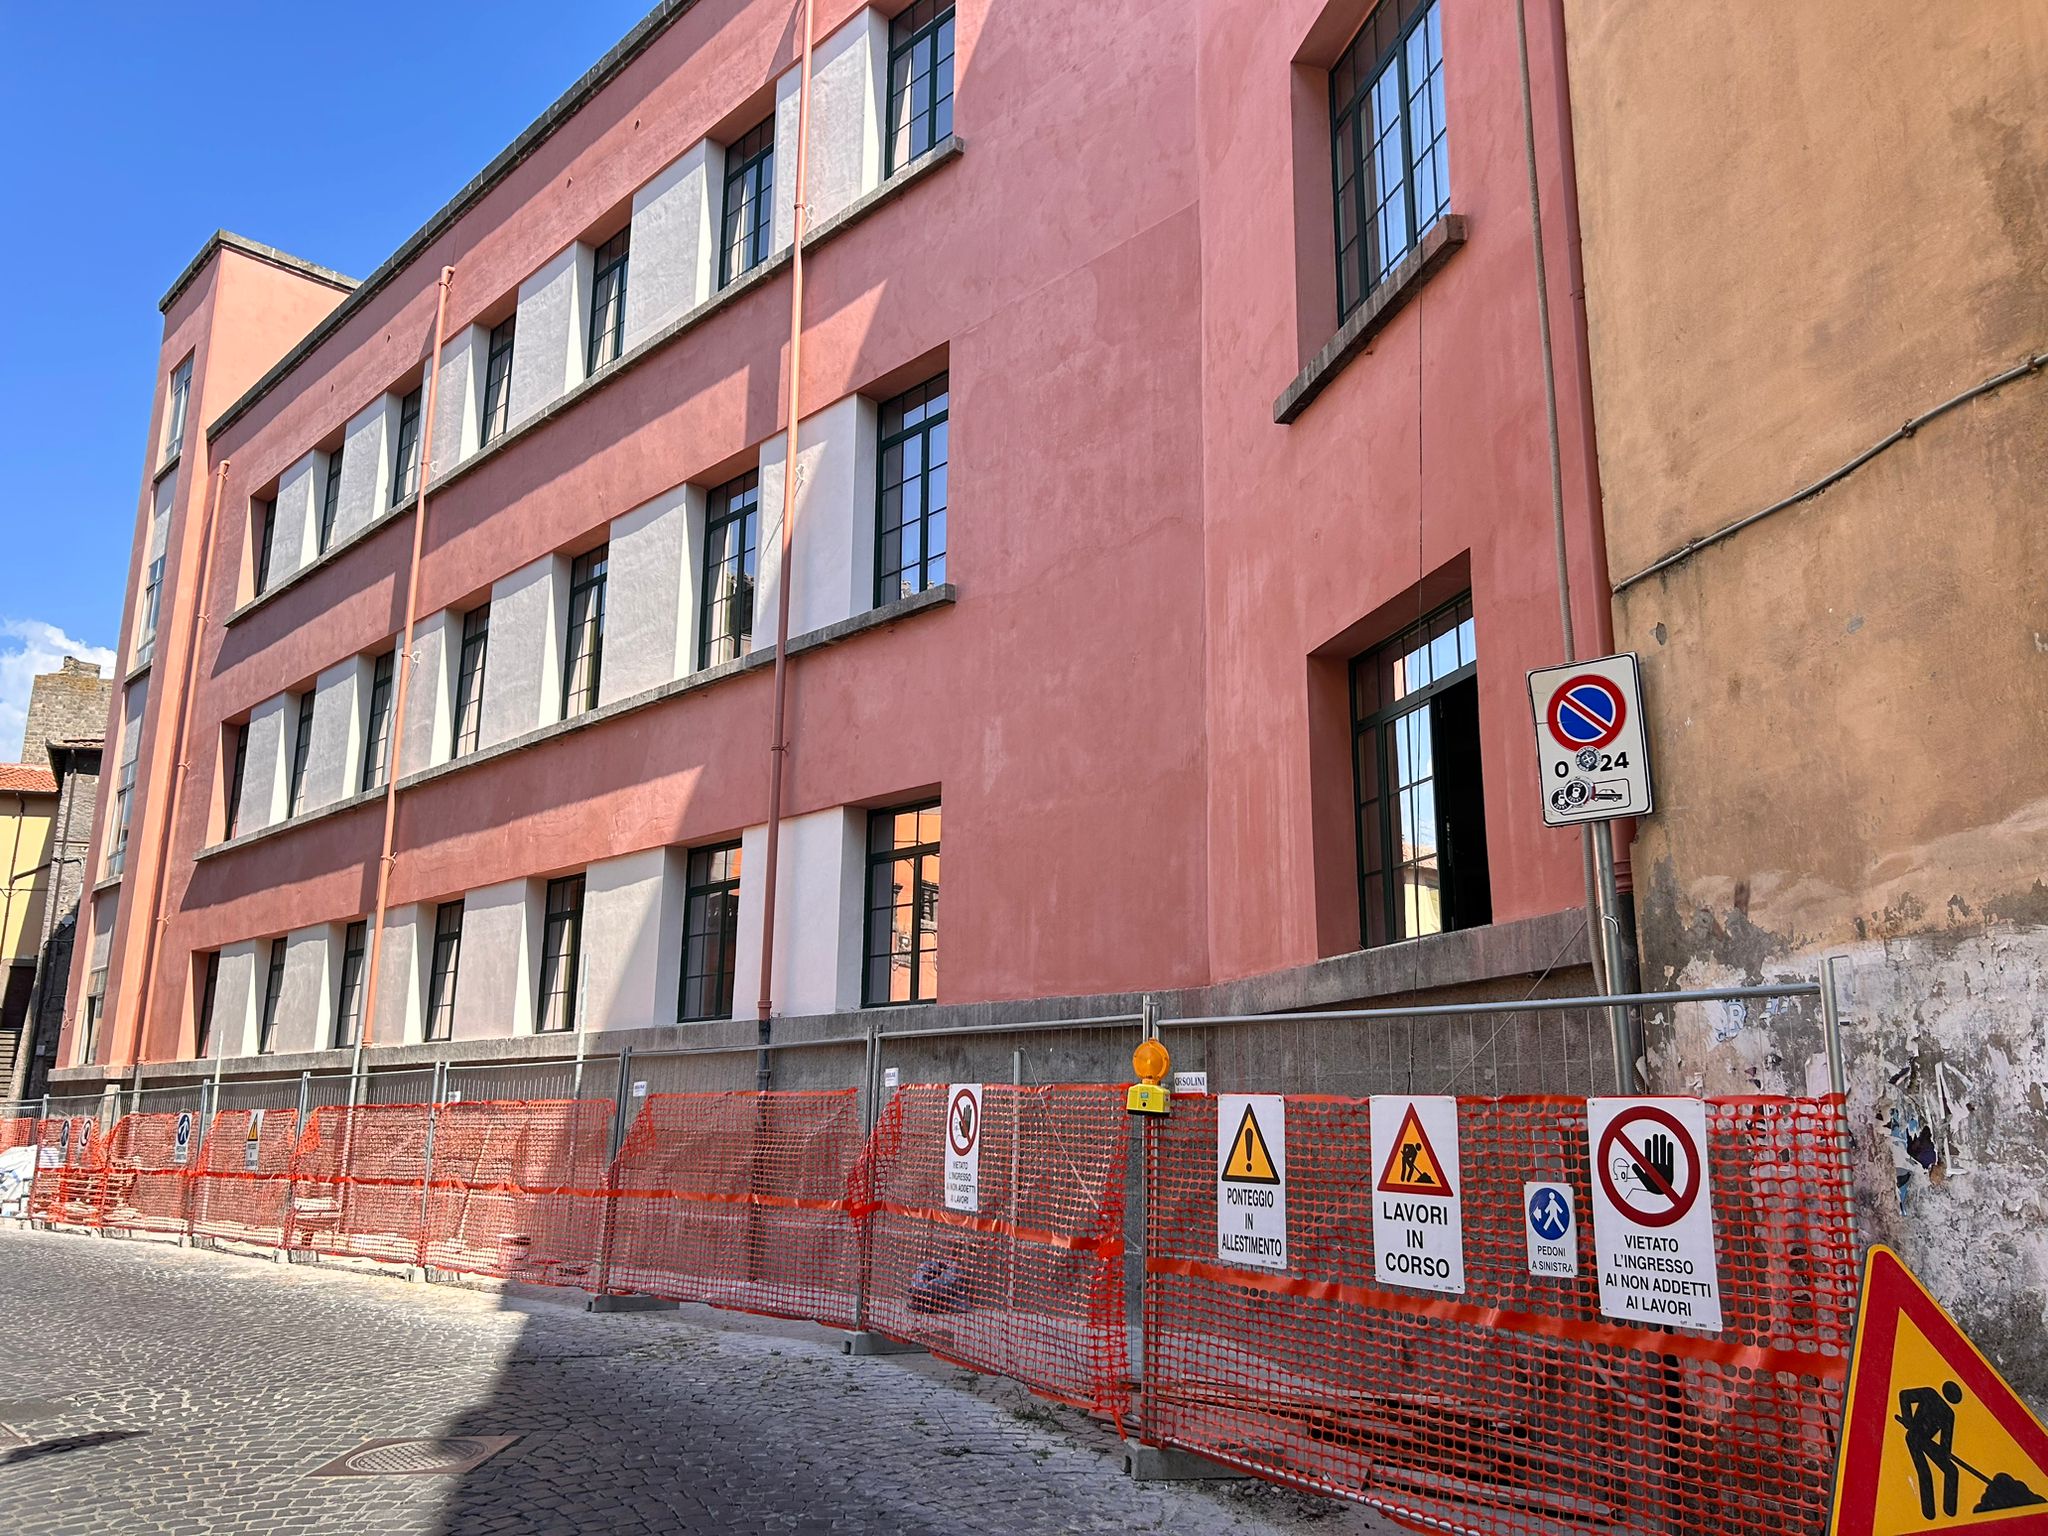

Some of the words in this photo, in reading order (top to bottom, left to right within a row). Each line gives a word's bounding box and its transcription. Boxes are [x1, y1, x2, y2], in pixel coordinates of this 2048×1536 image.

[1600, 751, 1629, 771] 24
[1175, 1076, 1204, 1086] ORSOLINI
[1226, 1187, 1274, 1208] PONTEGGIO
[1244, 1213, 1254, 1230] IN
[1383, 1201, 1448, 1225] LAVORI
[1221, 1233, 1282, 1257] ALLESTIMENTO
[1406, 1229, 1423, 1249] IN
[1624, 1234, 1679, 1252] VIETATO
[1537, 1245, 1566, 1257] PEDONI
[1385, 1252, 1450, 1279] CORSO
[1532, 1260, 1539, 1270] A
[1539, 1260, 1573, 1273] SINISTRA
[1614, 1254, 1694, 1275] L'INGRESSO
[1605, 1273, 1617, 1287] AI
[1621, 1275, 1649, 1290] NON
[1652, 1280, 1711, 1298] ADDETTI
[1626, 1295, 1639, 1309] AI
[1642, 1297, 1692, 1317] LAVORI
